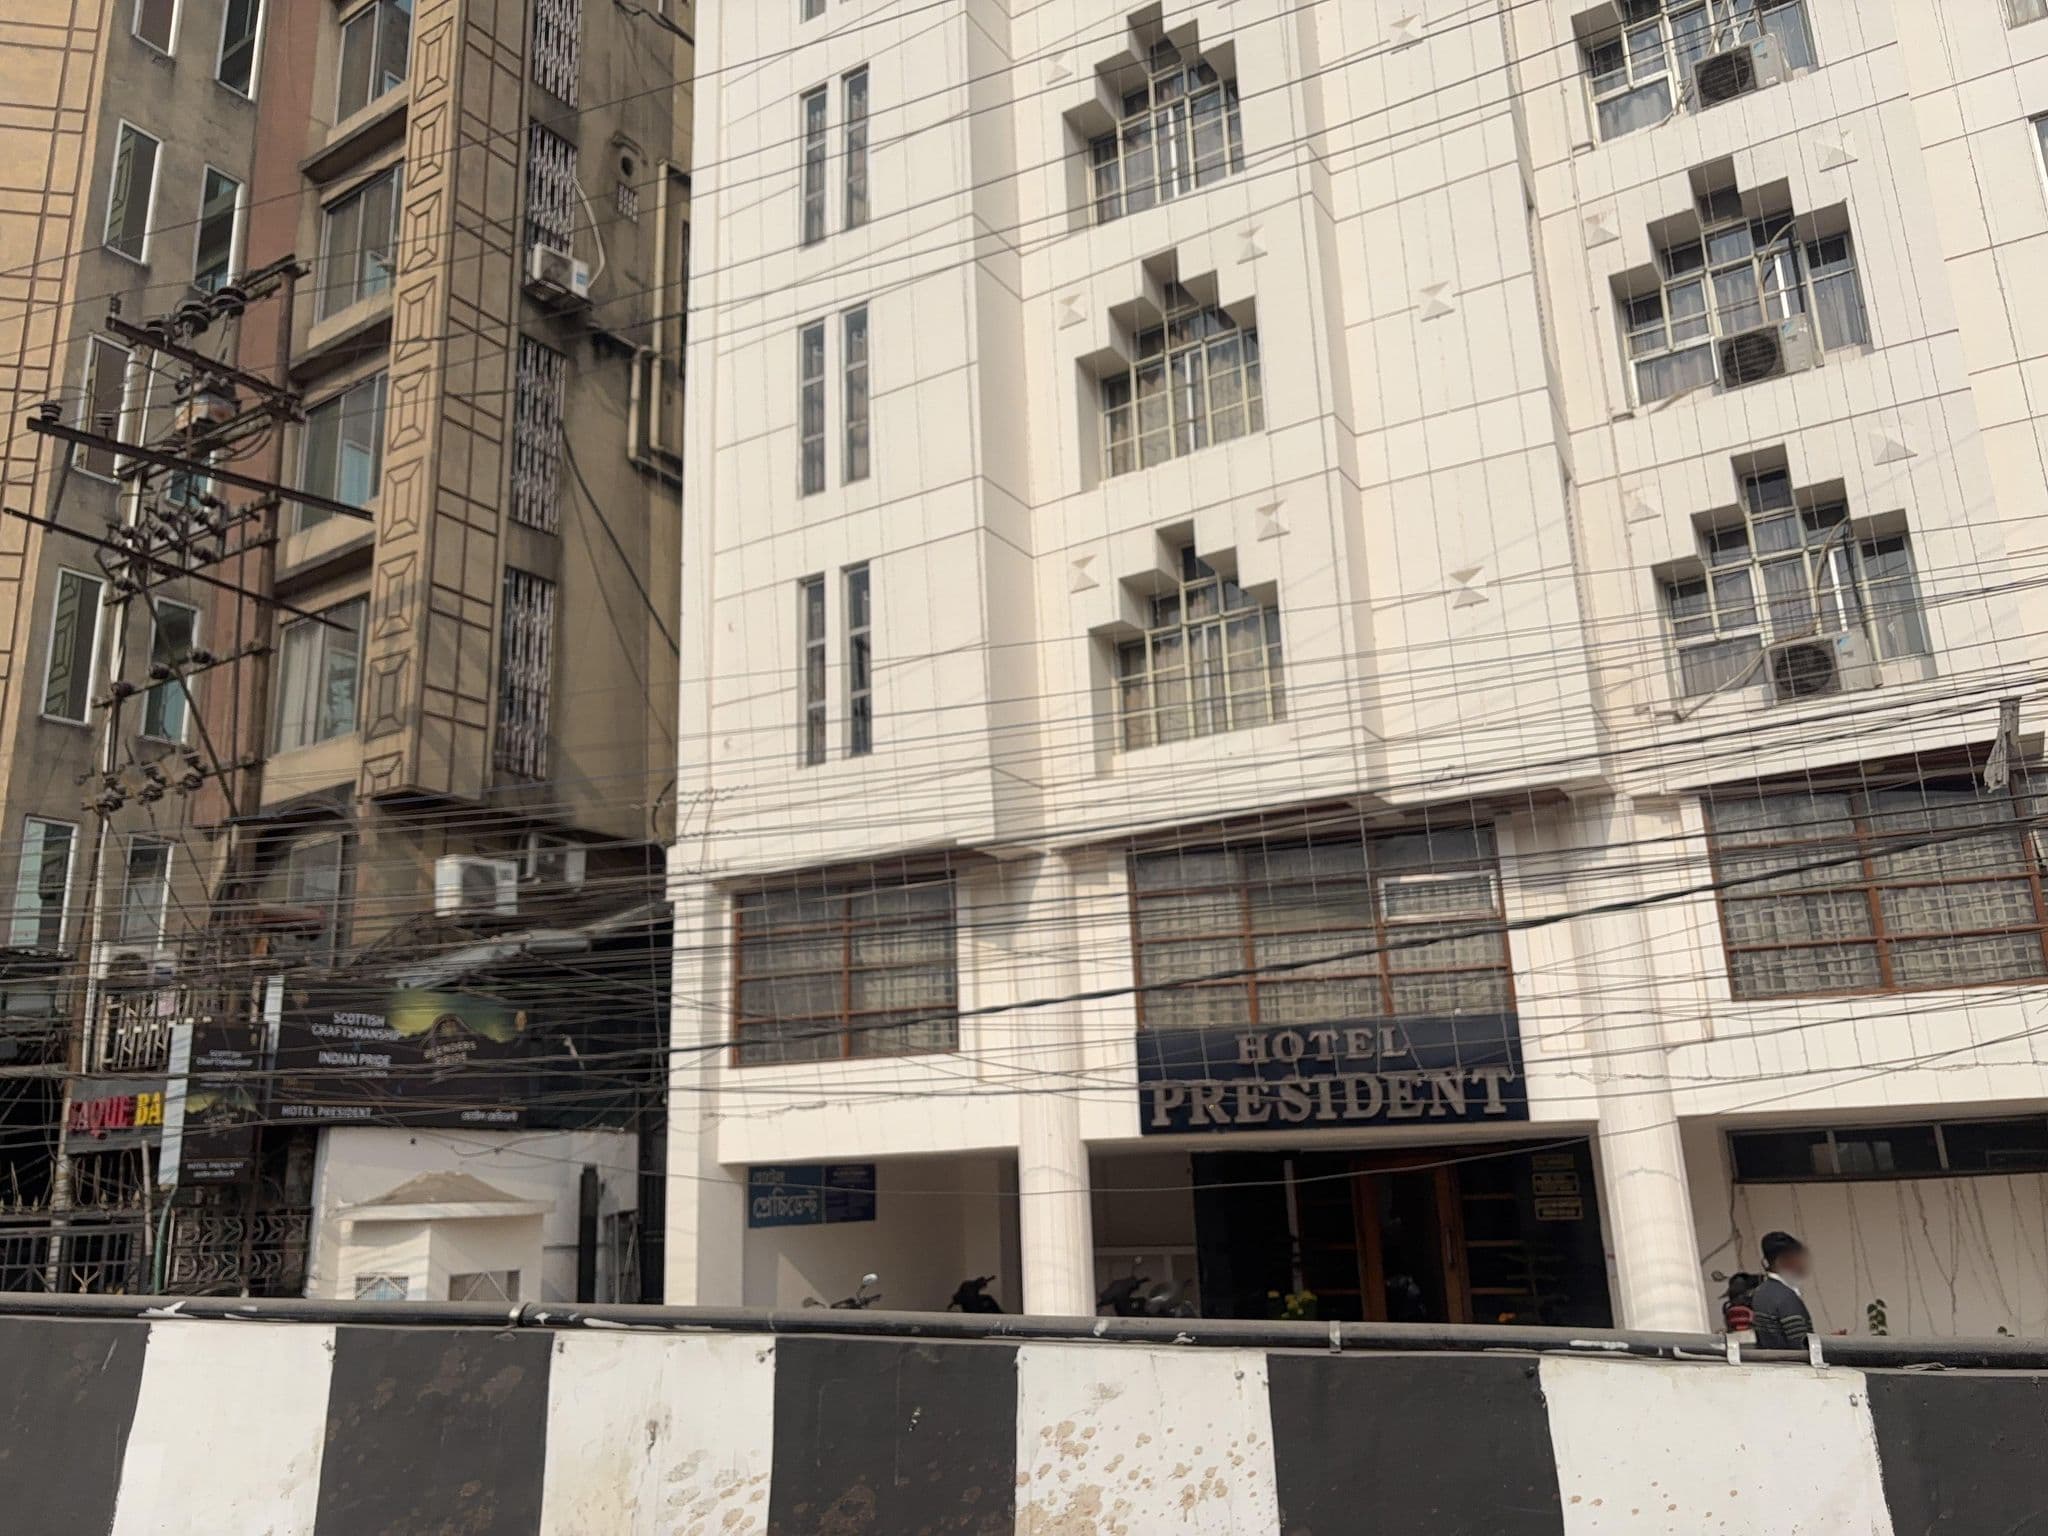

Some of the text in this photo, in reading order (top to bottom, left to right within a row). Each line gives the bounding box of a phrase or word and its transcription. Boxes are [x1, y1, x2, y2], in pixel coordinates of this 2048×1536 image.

[333, 1012, 385, 1027] SCOTTISH
[311, 1022, 402, 1040] CRAFTSMANSHIP
[1235, 1025, 1409, 1065] HOTEL
[318, 1050, 392, 1069] INDIAN PRIDE
[1150, 1067, 1515, 1127] PRESIDENT
[281, 1104, 372, 1120] HOTEL PRESIDENT
